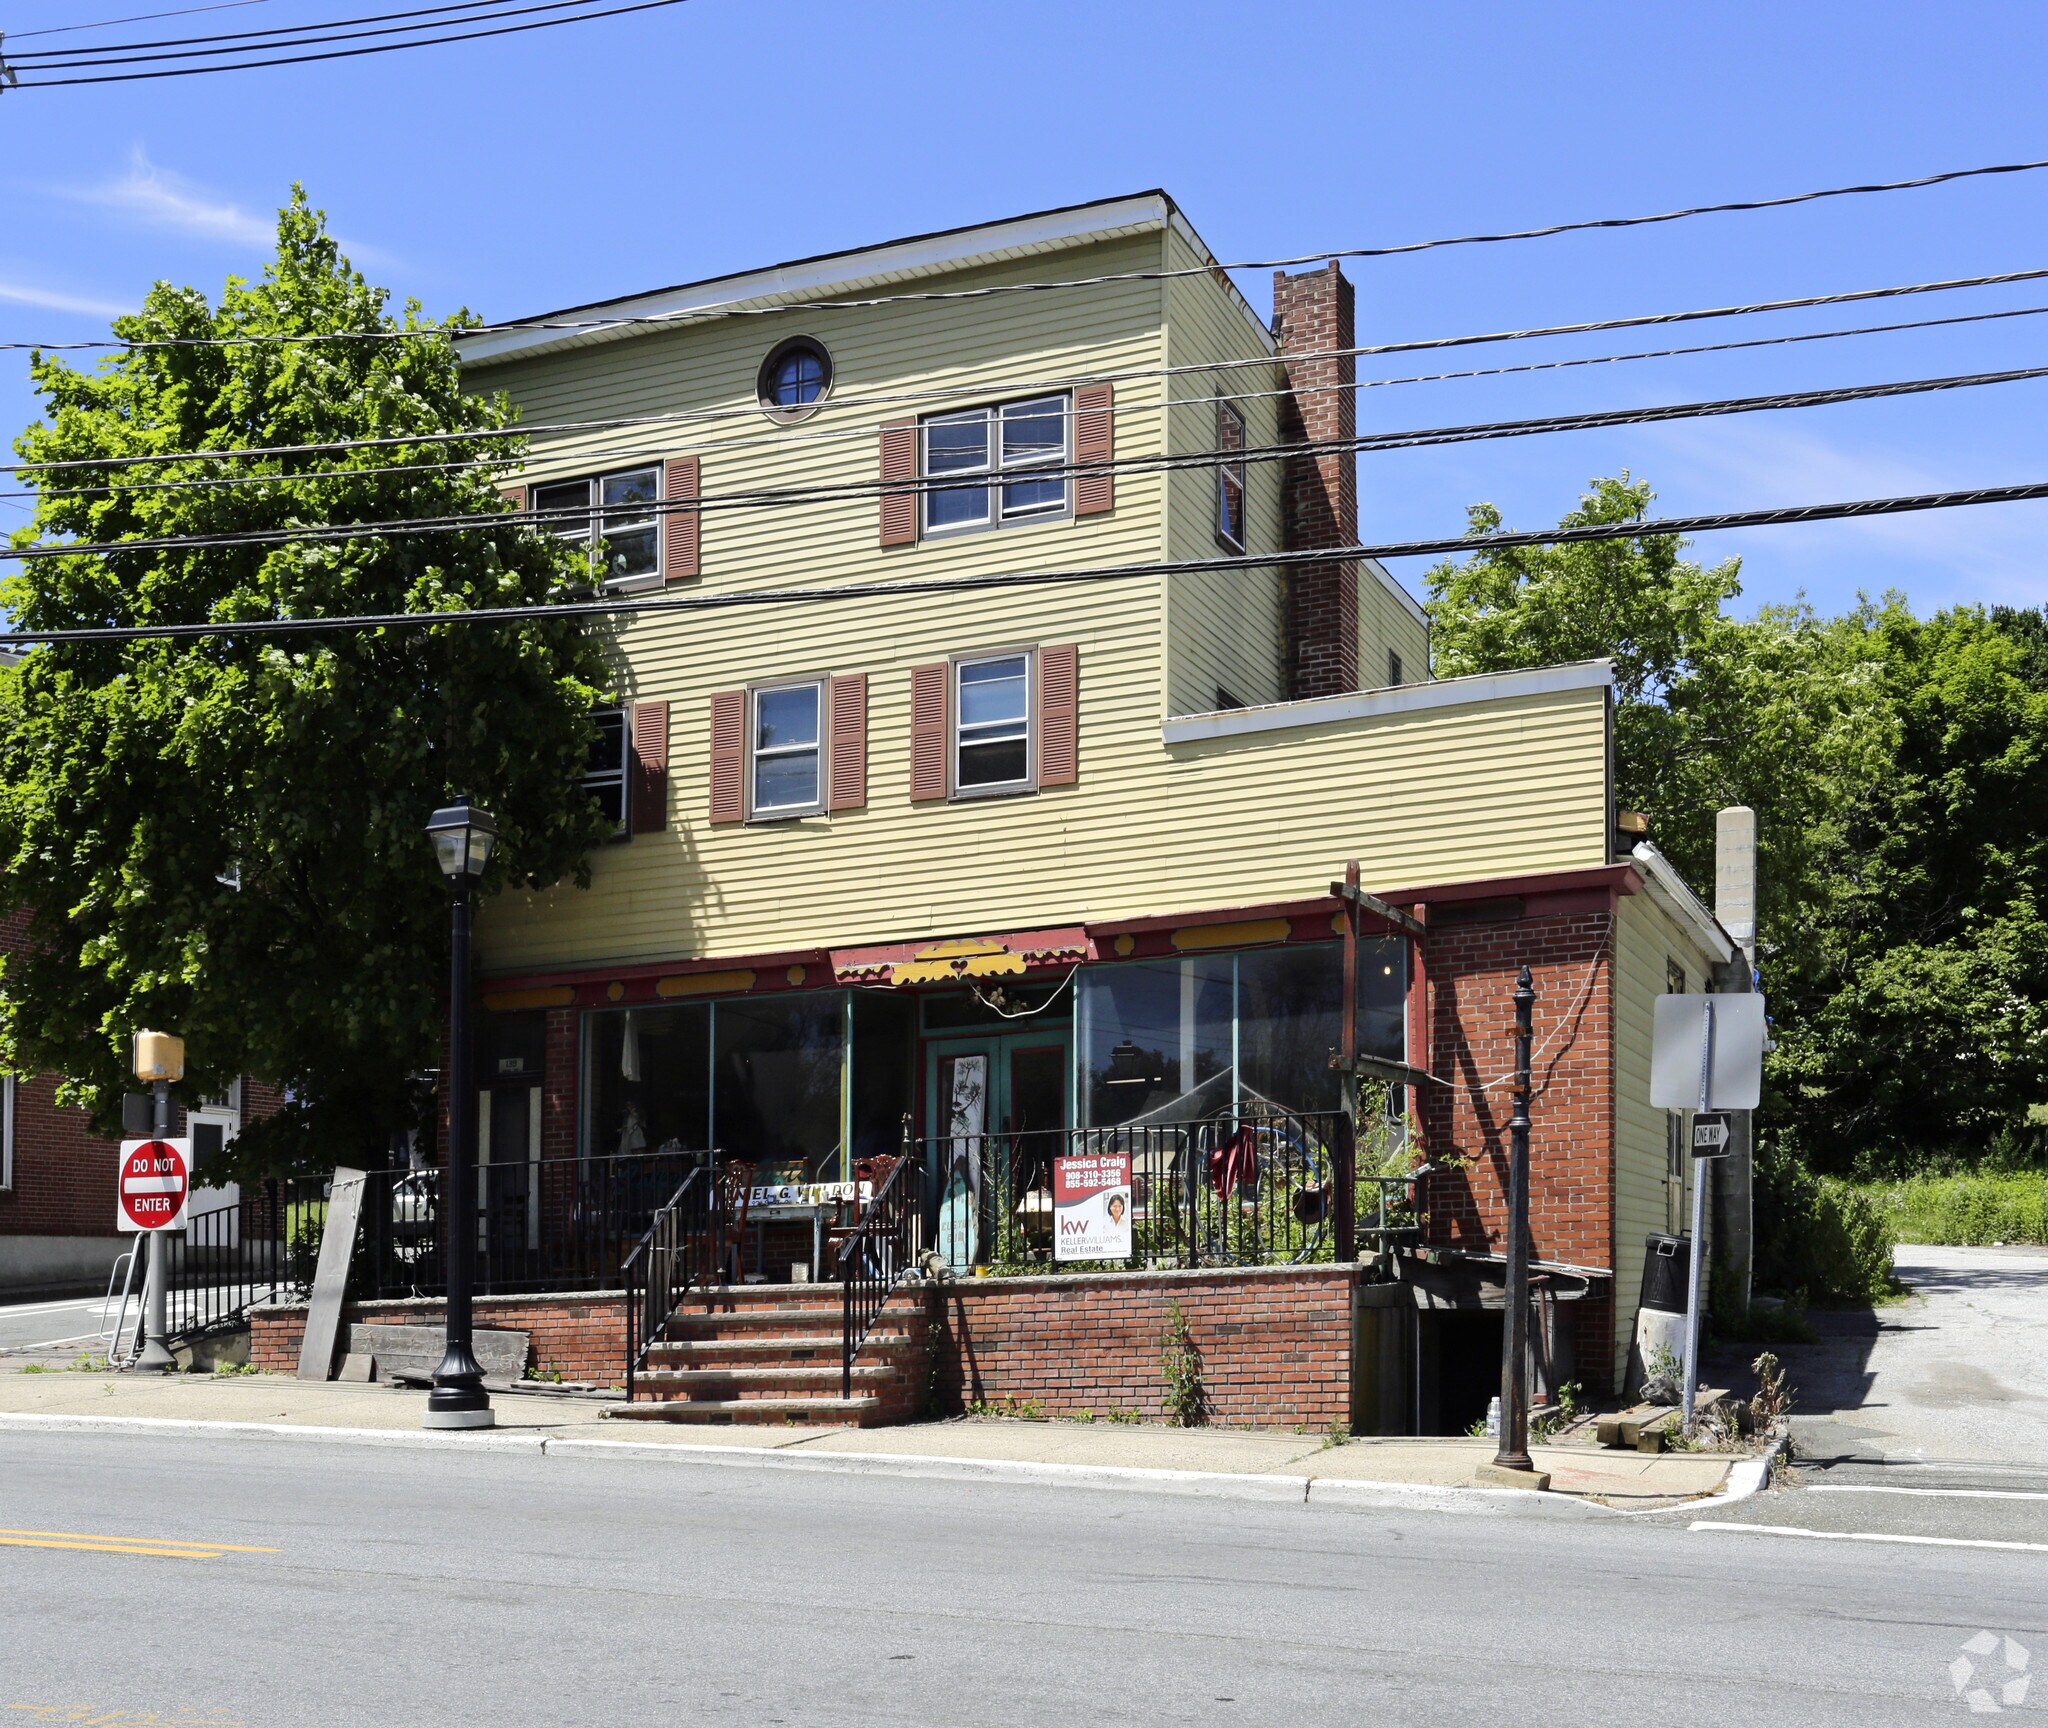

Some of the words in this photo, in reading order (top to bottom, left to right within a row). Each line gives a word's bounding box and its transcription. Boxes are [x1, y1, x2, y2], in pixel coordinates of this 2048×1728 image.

[1695, 1127, 1708, 1144] ONE
[1709, 1126, 1721, 1143] WAY
[132, 1158, 148, 1173] DO
[153, 1158, 176, 1172] NOT
[1060, 1159, 1097, 1170] Jessica
[1100, 1156, 1126, 1168] Craig
[1065, 1169, 1121, 1180] 908-310-3356
[1065, 1178, 1121, 1188] 855-592-5468
[134, 1198, 170, 1212] ENTER
[1061, 1246, 1078, 1254] Real
[1080, 1245, 1103, 1253] Estate
